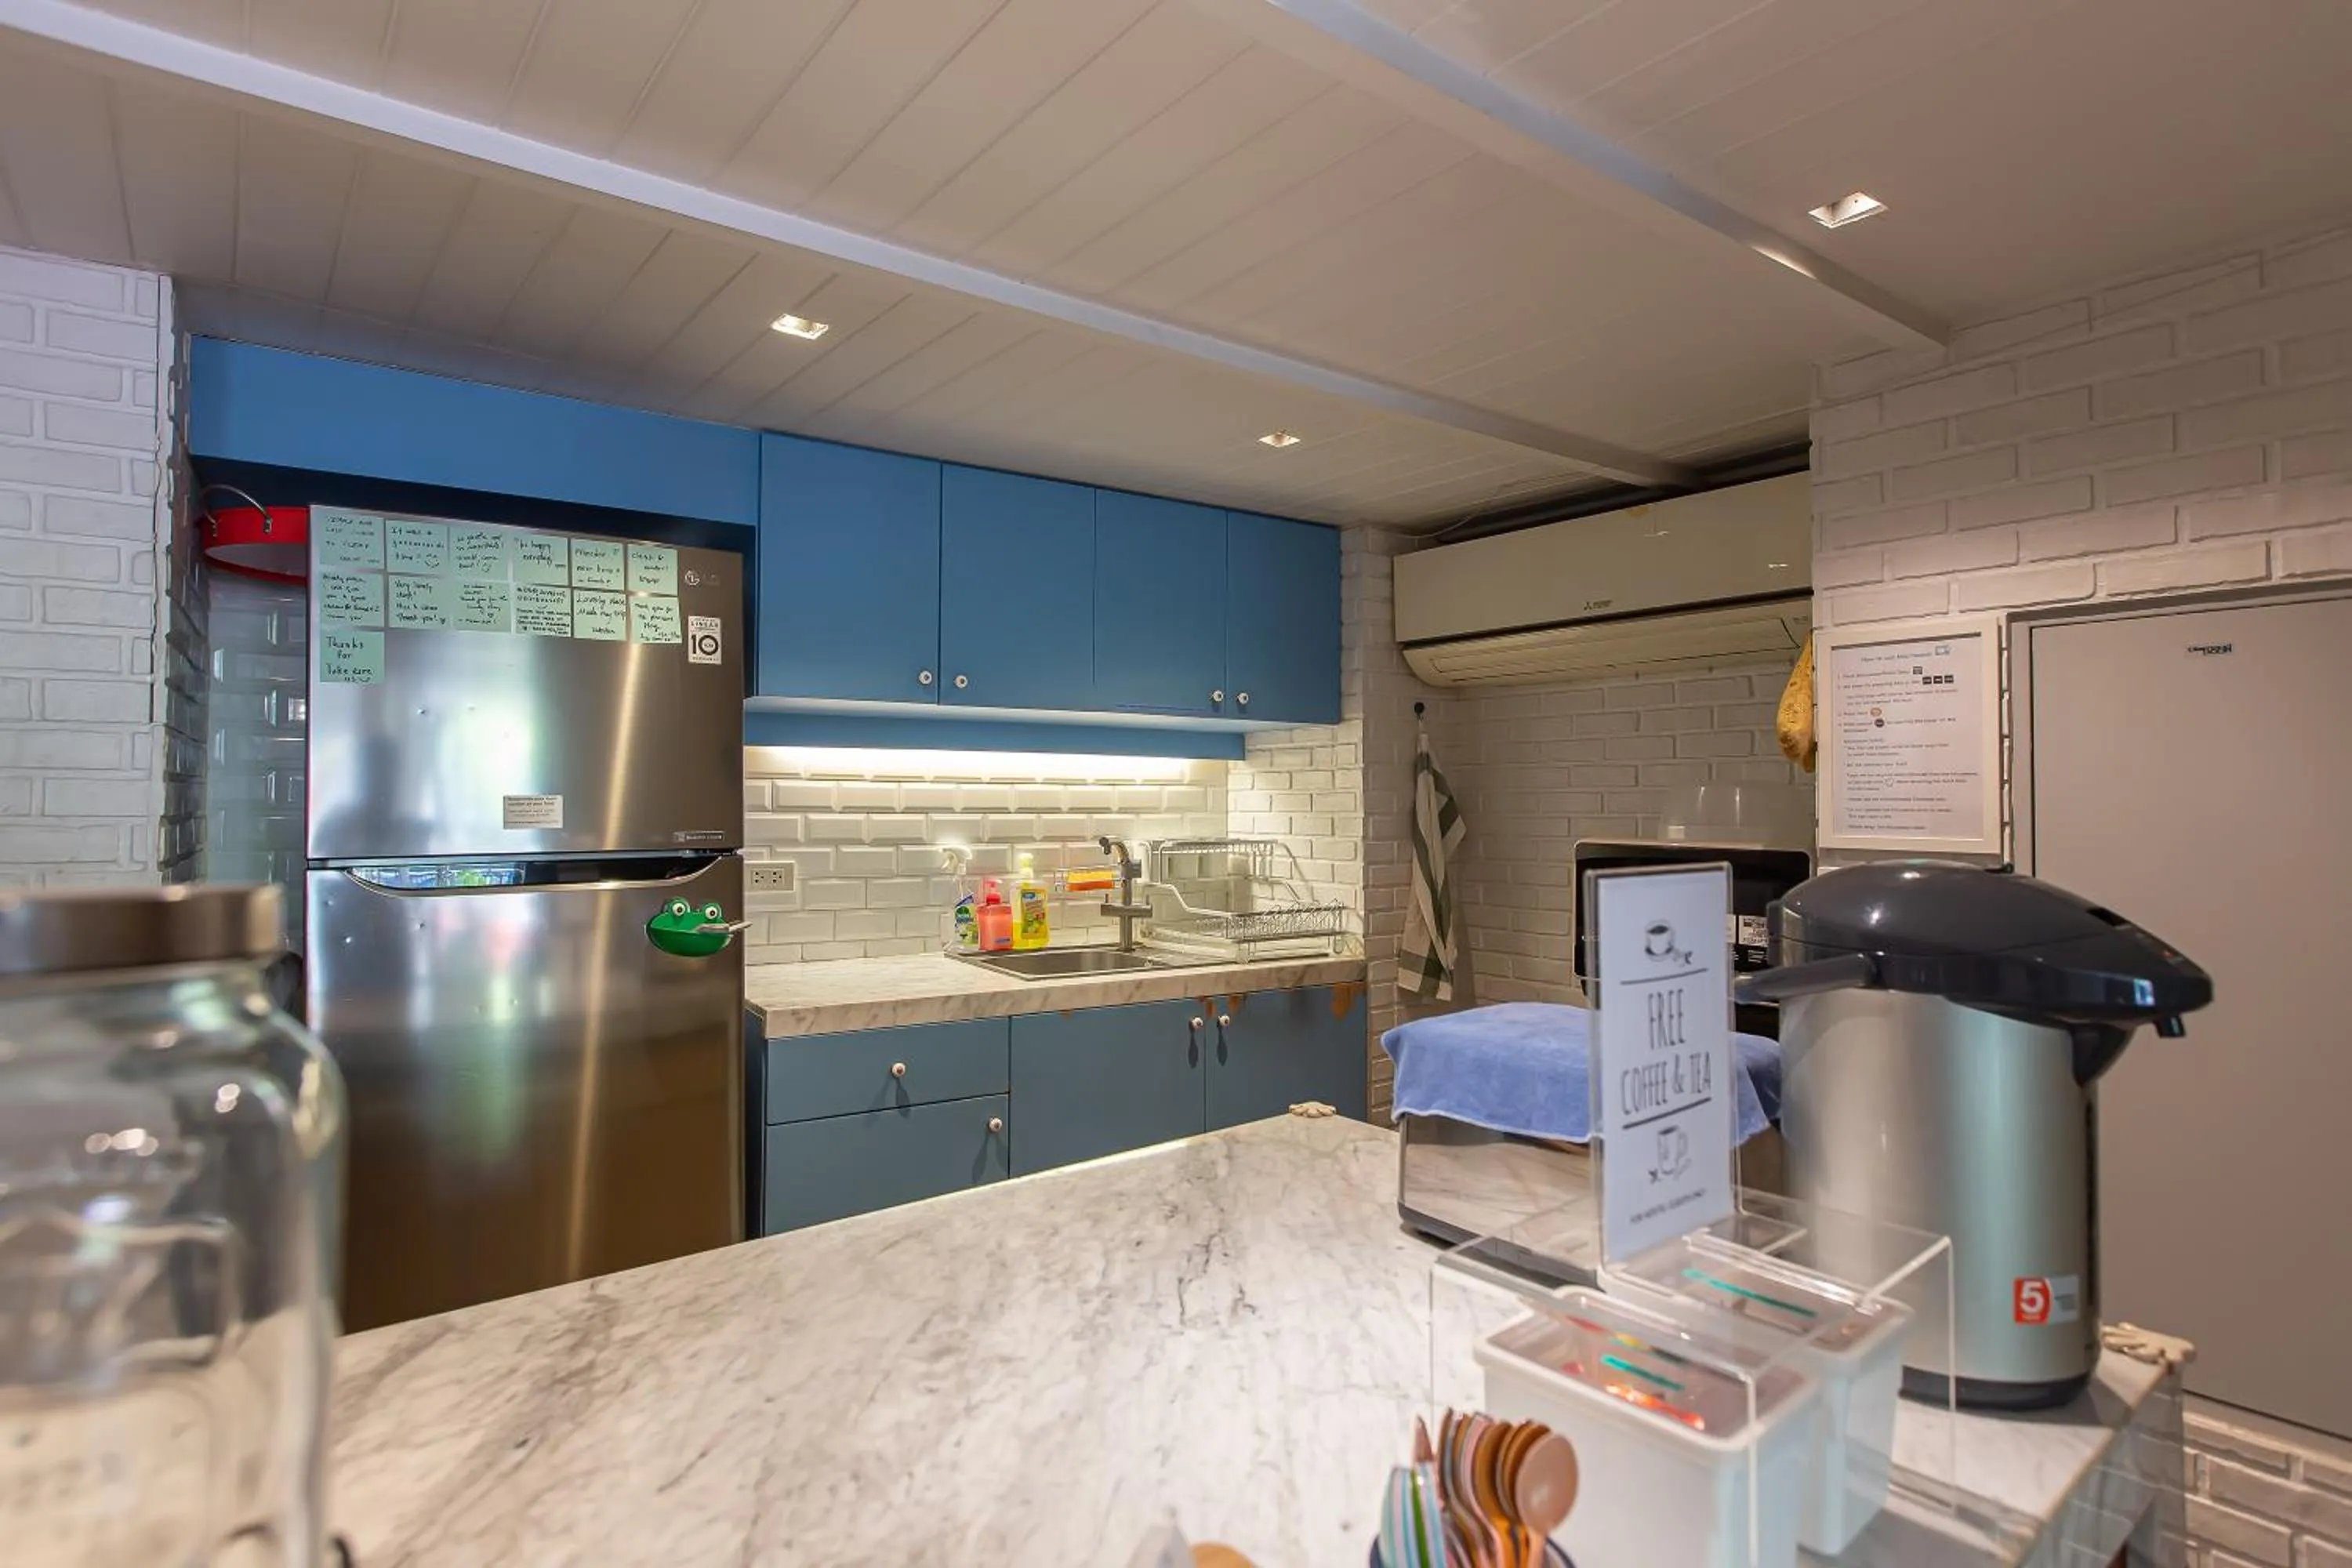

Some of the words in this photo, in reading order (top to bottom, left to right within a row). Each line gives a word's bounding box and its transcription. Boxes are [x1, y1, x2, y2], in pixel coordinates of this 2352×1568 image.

[325, 636, 364, 650] Thanks
[691, 634, 719, 655] 10
[1648, 988, 1686, 1051] FREE
[1621, 1060, 1668, 1116] COFFEE
[1671, 1054, 1685, 1095] &
[1689, 1050, 1711, 1094] TEA
[2019, 1279, 2045, 1315] 5
